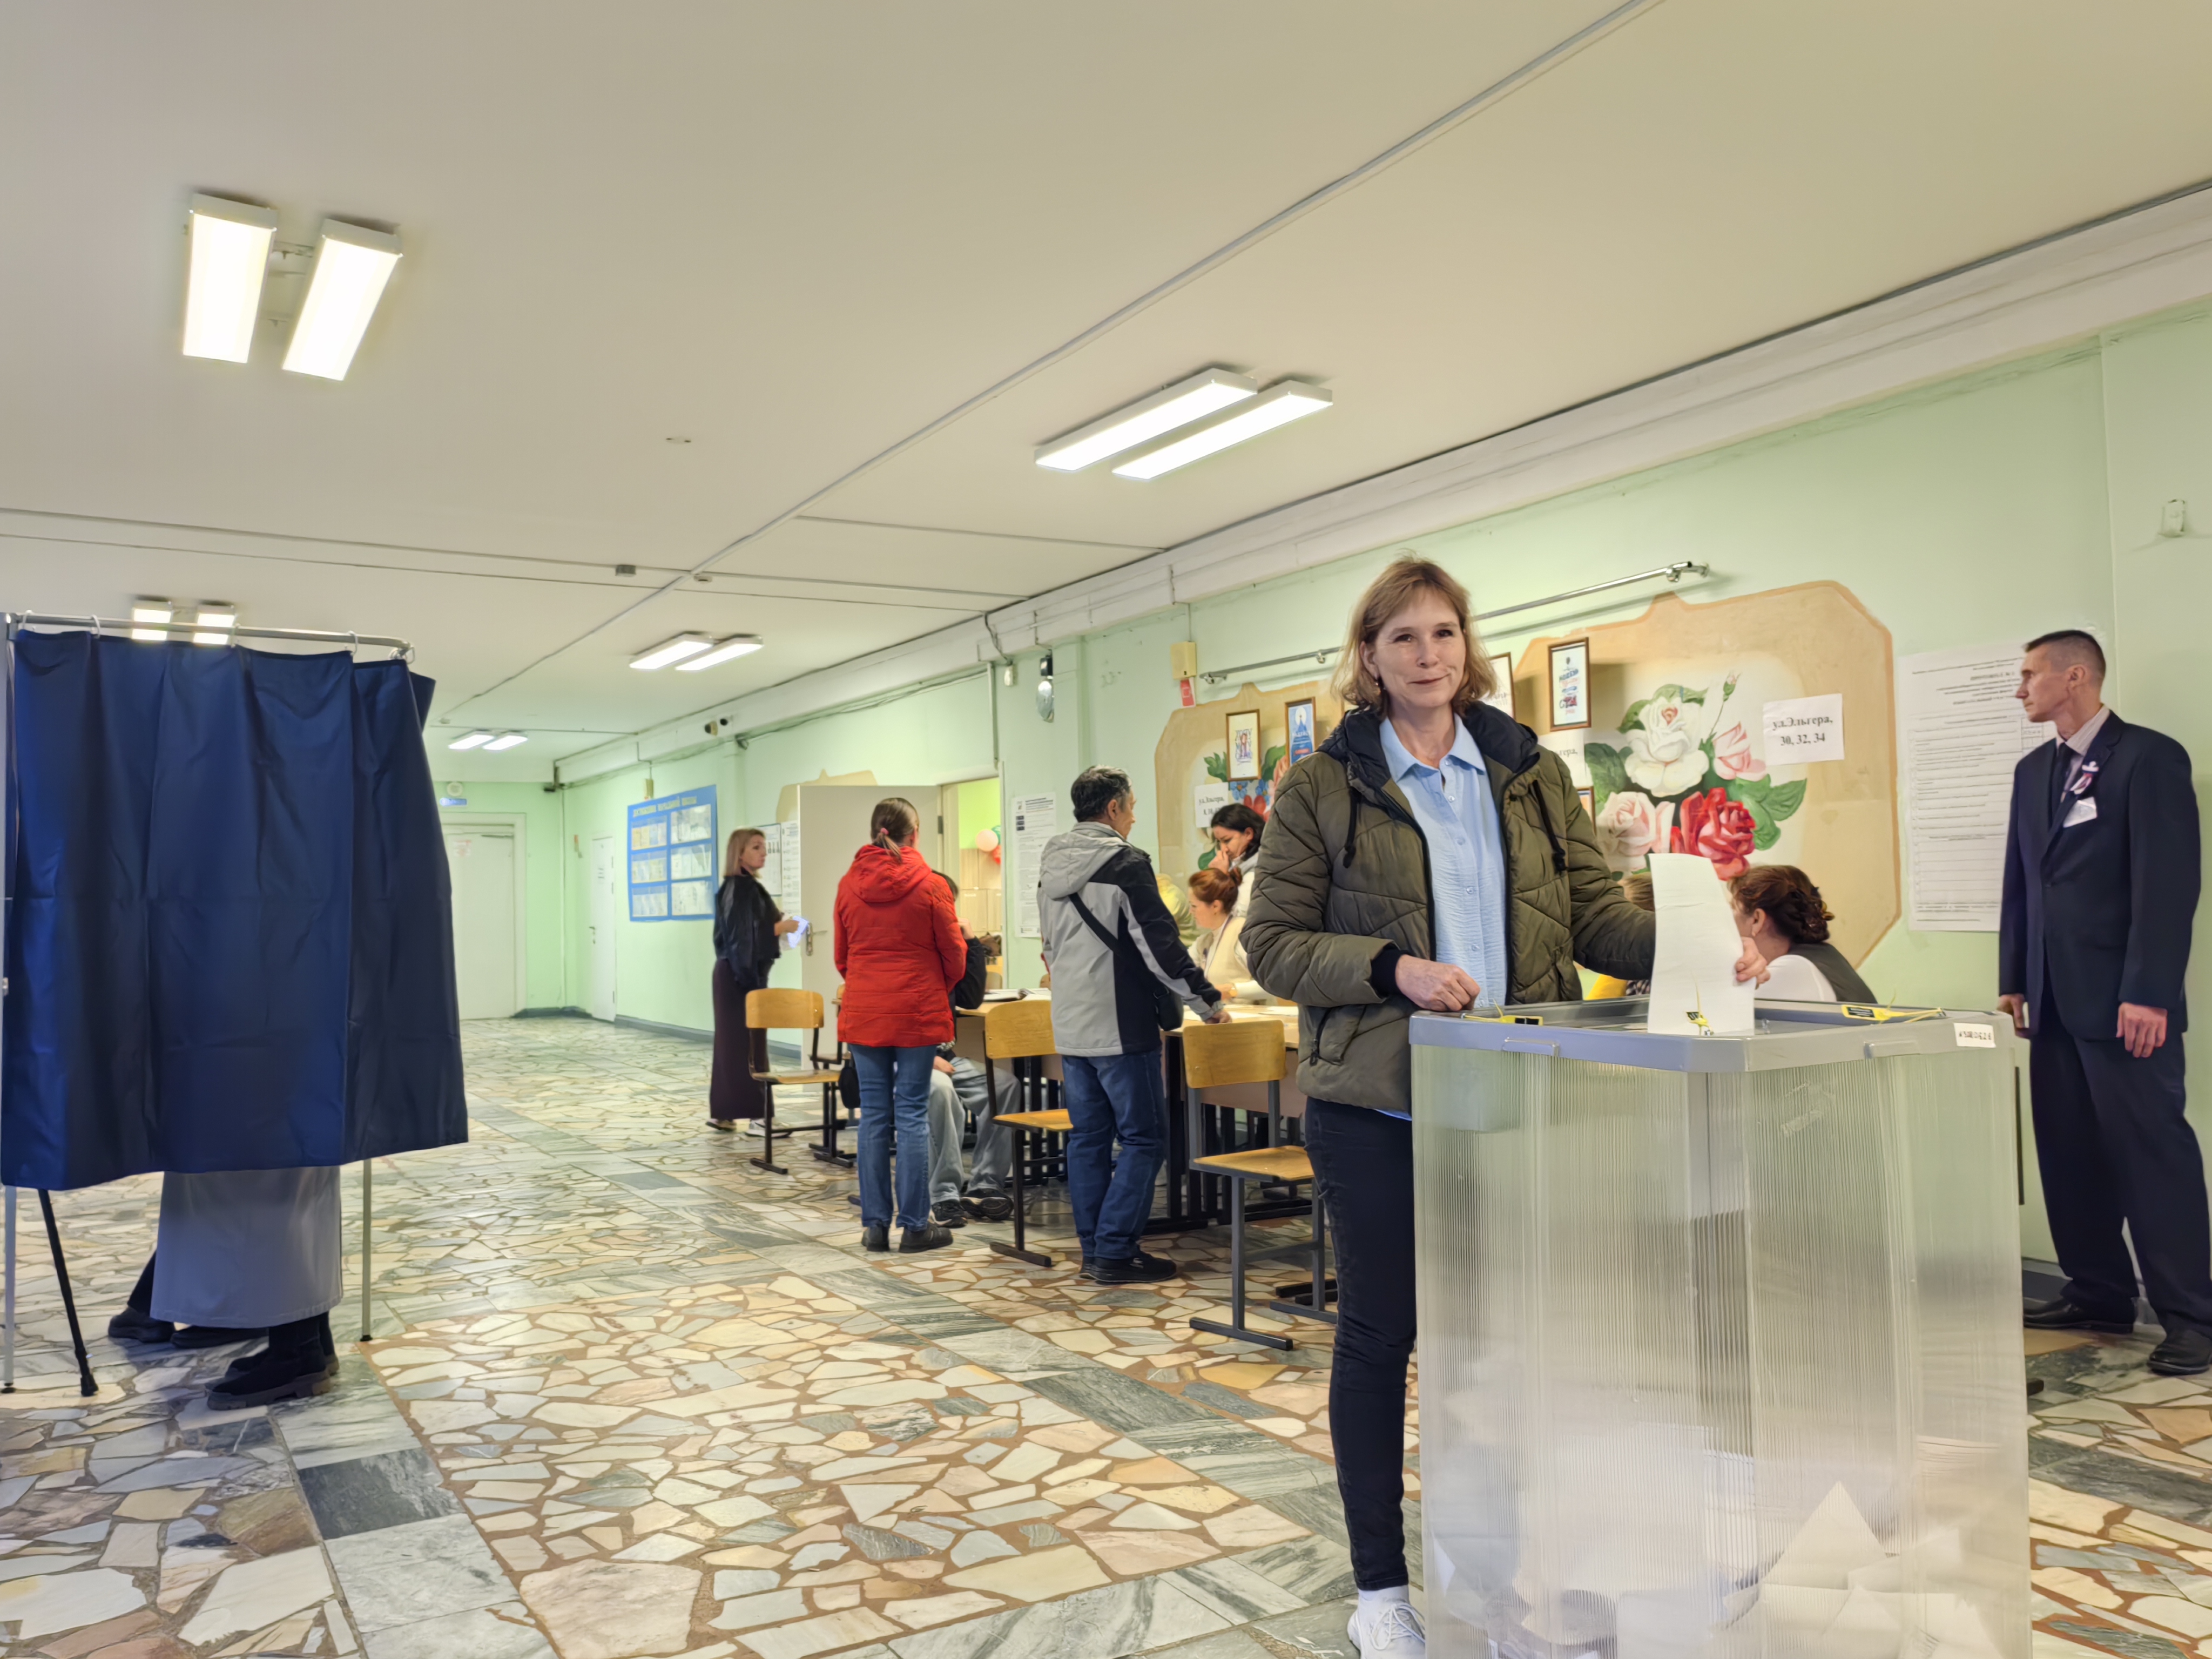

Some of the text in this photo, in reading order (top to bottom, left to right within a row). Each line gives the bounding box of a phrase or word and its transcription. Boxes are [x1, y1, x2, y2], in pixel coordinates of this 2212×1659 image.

[1772, 716, 1833, 731] ул.Эльгера,
[1780, 732, 1825, 746] 30, 32, 34
